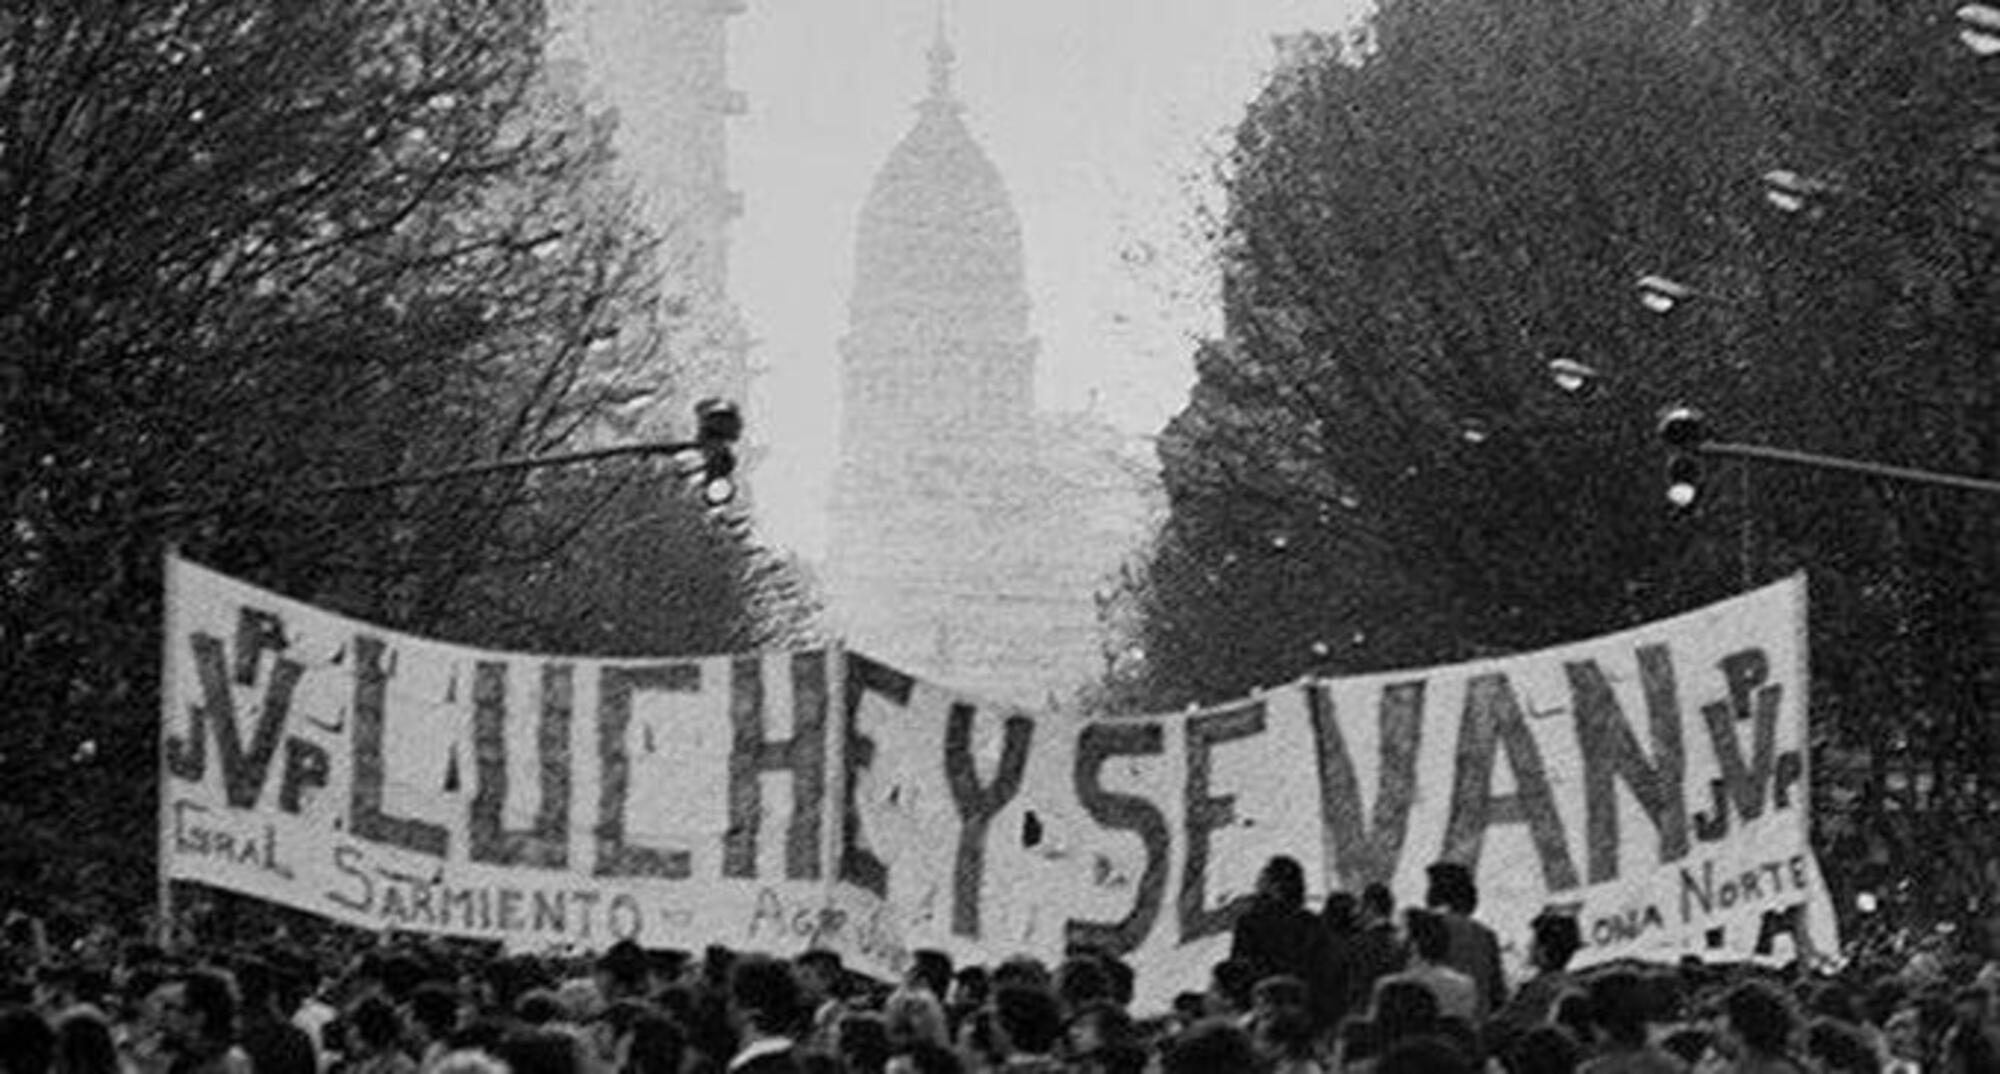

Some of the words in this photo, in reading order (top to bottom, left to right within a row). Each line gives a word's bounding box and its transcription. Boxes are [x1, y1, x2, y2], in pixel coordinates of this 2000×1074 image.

[349, 634, 916, 901] LUCHE
[944, 702, 1035, 939] Y
[1064, 700, 1267, 957] SE
[1305, 642, 1690, 893] VAN
[1679, 855, 1807, 924] NORTE
